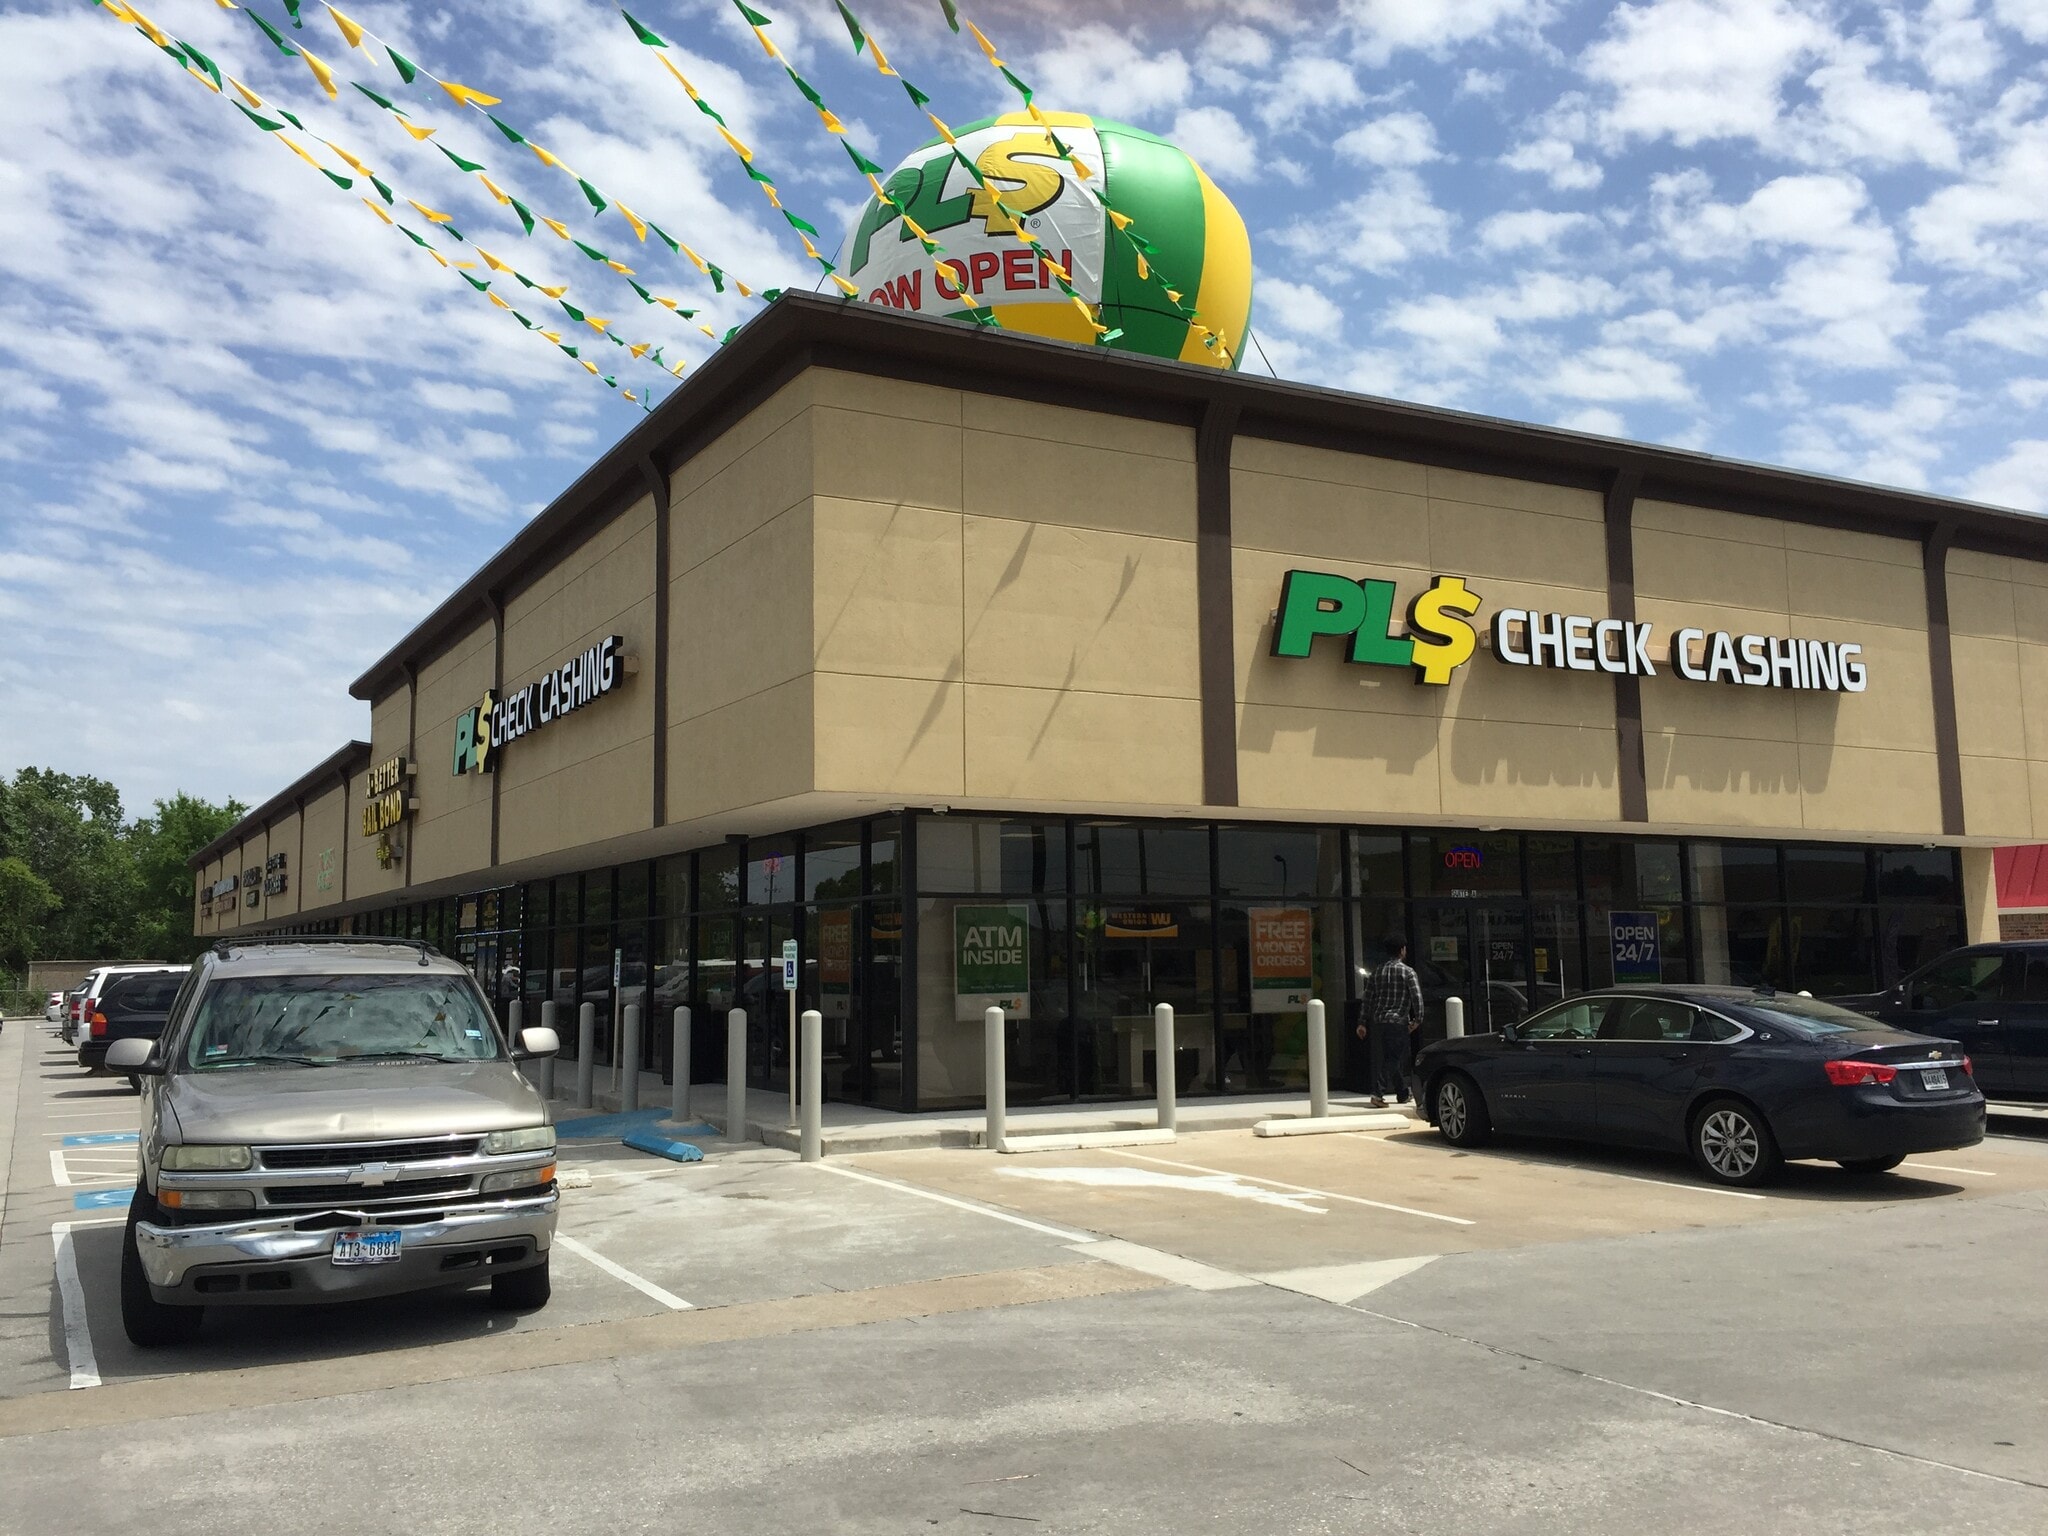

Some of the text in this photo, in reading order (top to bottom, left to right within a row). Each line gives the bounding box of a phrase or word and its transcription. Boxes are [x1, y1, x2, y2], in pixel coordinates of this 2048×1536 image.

[934, 248, 1073, 300] OPEN
[1274, 569, 1868, 692] PL$ CHECK CASHING
[491, 683, 533, 748] CHECK
[540, 635, 614, 723] CASHING
[1445, 852, 1480, 868] OPEN
[963, 926, 1022, 947] ATM
[1256, 921, 1306, 939] FREE
[1614, 926, 1654, 940] OPEN
[1257, 941, 1306, 953] MONEY
[1492, 942, 1514, 950] OPEN
[1615, 941, 1654, 963] 24/7
[963, 949, 1022, 965] INSIDE
[1257, 955, 1306, 967] ORDERS
[1492, 951, 1514, 961] 24/7
[369, 1240, 398, 1257] 6881
